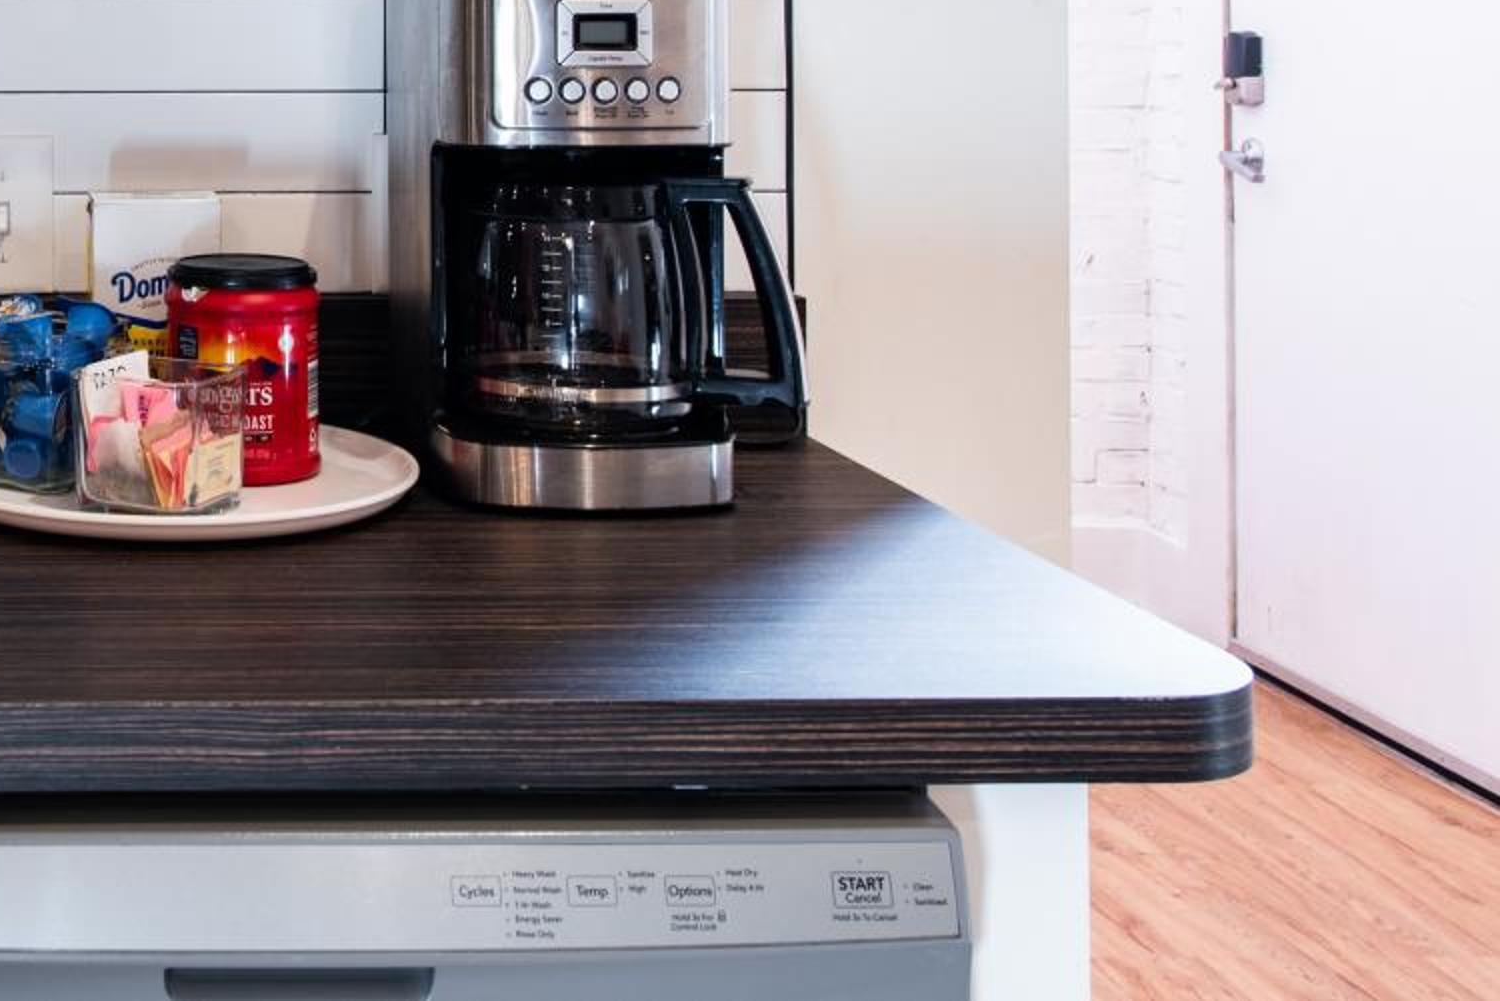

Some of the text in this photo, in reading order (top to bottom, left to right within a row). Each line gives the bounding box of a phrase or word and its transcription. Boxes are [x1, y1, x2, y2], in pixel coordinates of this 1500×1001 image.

[111, 271, 169, 304] Dom
[744, 868, 758, 878] Dry
[576, 884, 609, 899] Temp
[668, 884, 713, 899] Options
[838, 876, 885, 892] START
[459, 885, 495, 899] Cycles
[845, 892, 882, 904] Cancel
